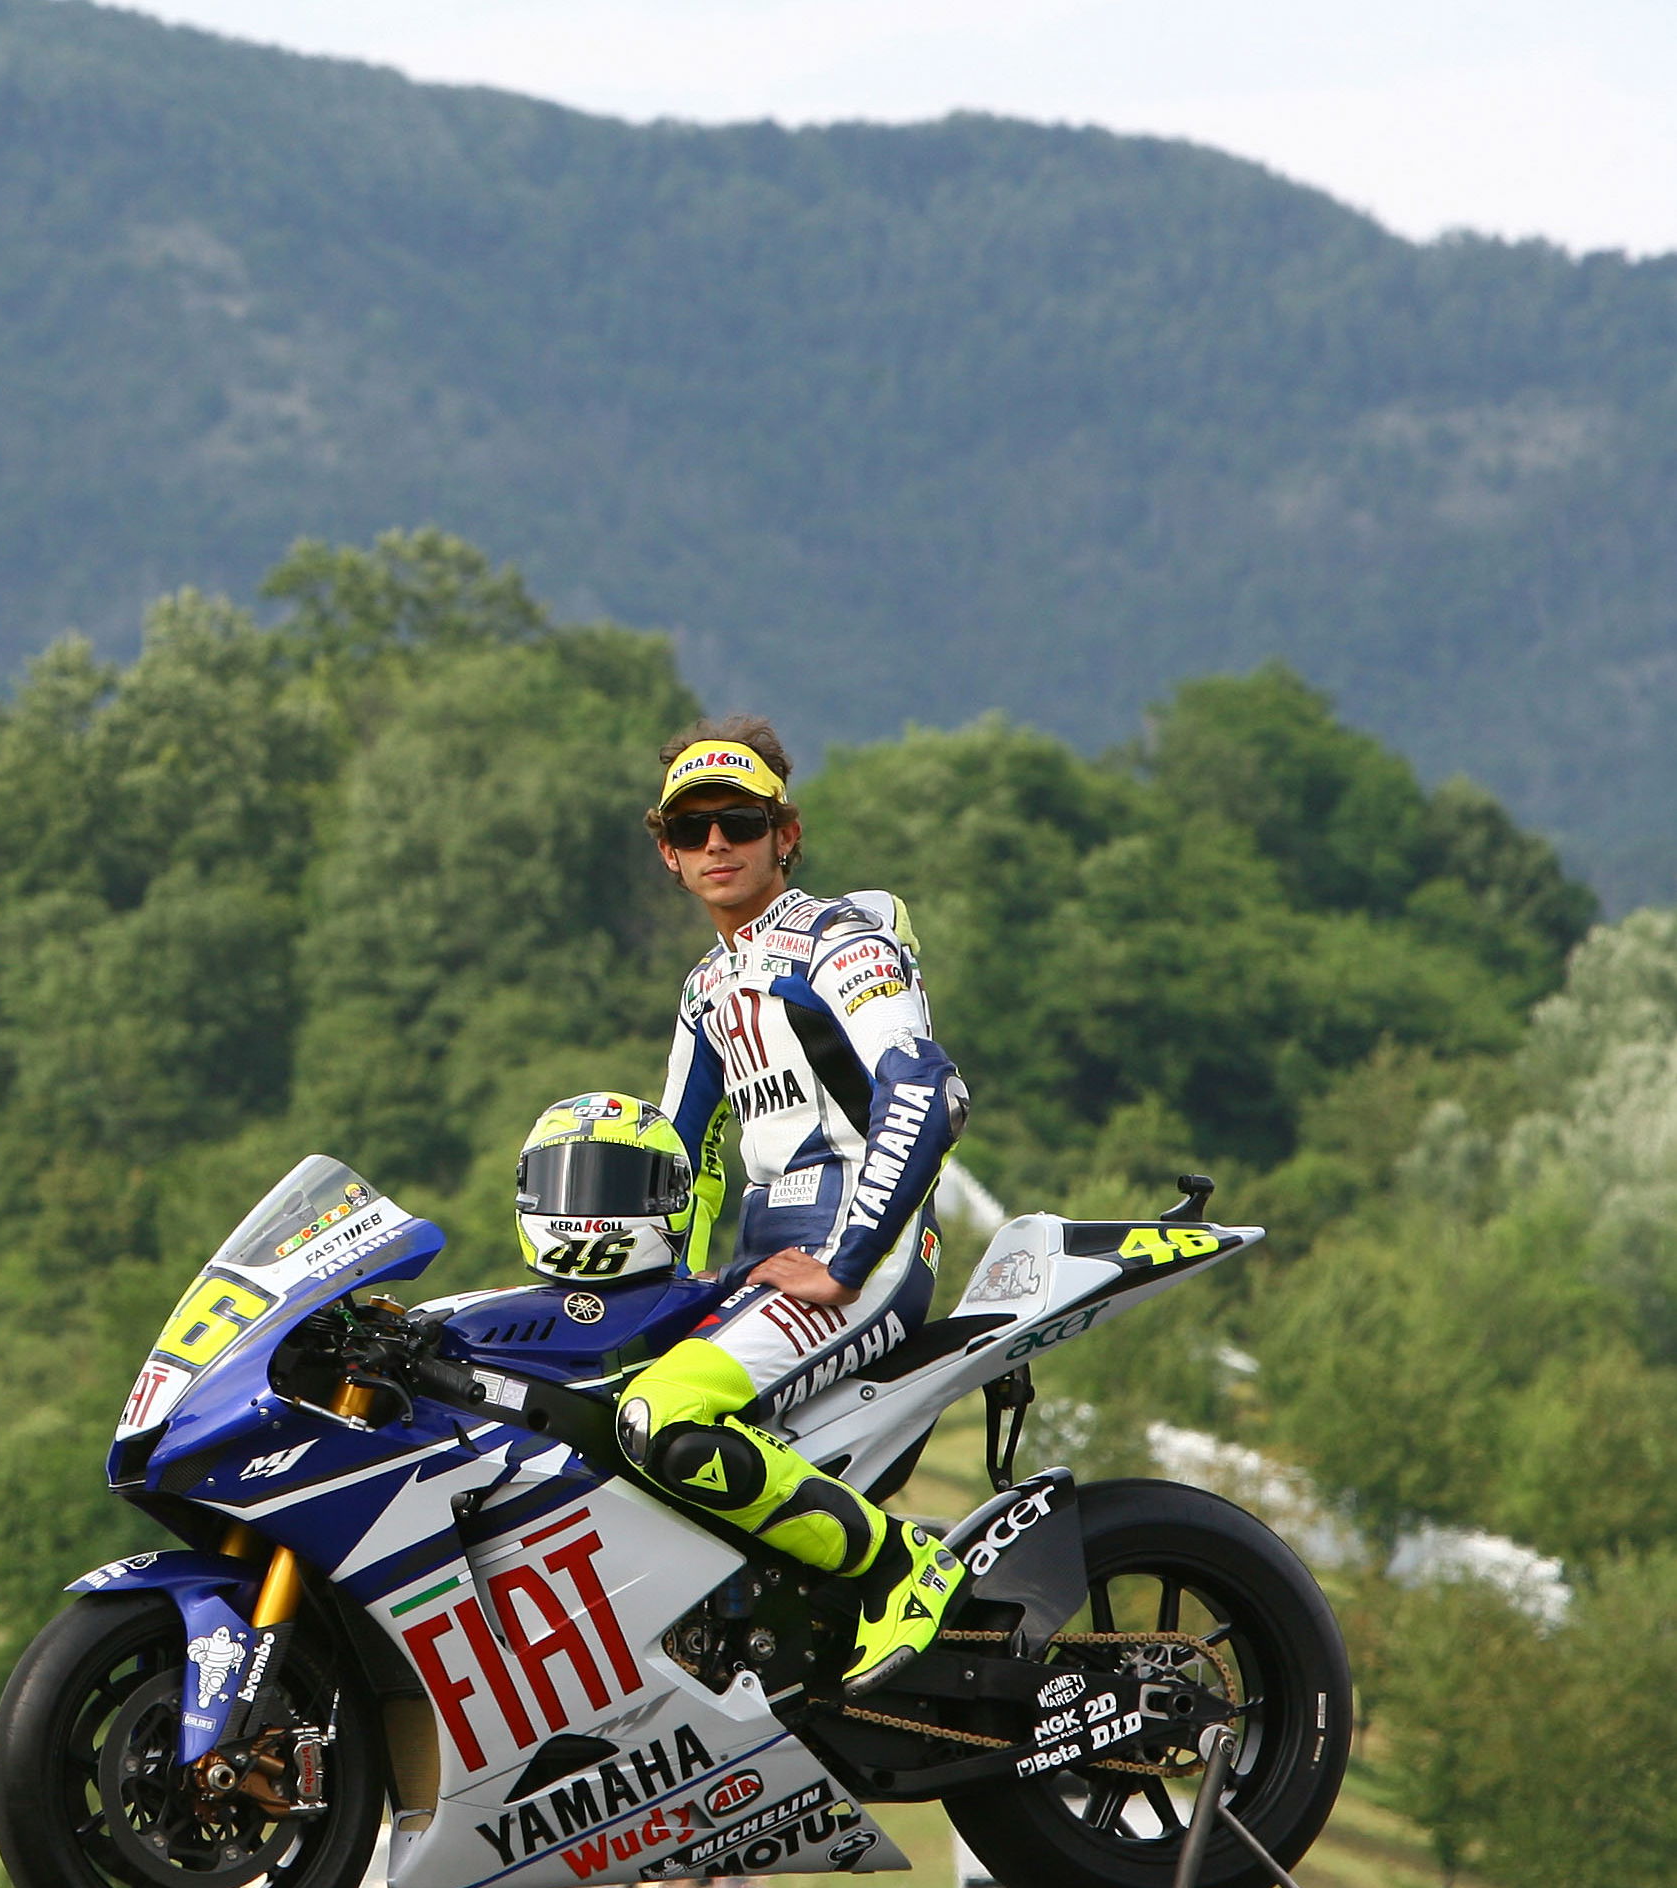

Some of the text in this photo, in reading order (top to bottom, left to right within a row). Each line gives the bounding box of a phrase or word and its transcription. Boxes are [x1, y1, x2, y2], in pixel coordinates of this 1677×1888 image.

[672, 752, 753, 780] KERAKOLL
[776, 934, 811, 956] YAMAHA
[832, 944, 879, 971] Wudy
[838, 964, 904, 998] KERAKO
[574, 1106, 621, 1119] agv
[848, 1083, 936, 1230] YAMAHA
[774, 1186, 813, 1198] LONDON
[306, 1213, 383, 1265] FASTWEB
[550, 1220, 623, 1233] KERAKOLL
[309, 1229, 403, 1280] YAMAHA
[542, 1236, 636, 1276] 46
[1118, 1228, 1219, 1265] 46
[1006, 1300, 1110, 1361] acer
[773, 1310, 906, 1417] YAMAHA
[964, 1484, 1056, 1577] acer
[237, 1632, 275, 1703] brembo
[401, 1529, 644, 1773] FIAT
[1036, 1673, 1087, 1704] MAGNETI
[1038, 1676, 1086, 1708] MARELLI
[1084, 1692, 1117, 1723] 2D
[1033, 1708, 1081, 1742] NGK
[1090, 1710, 1142, 1750] D.I.D
[302, 1746, 316, 1793] brembo
[1033, 1742, 1082, 1772] Beta
[474, 1723, 715, 1867] YAMAHA
[711, 1774, 761, 1812] AIA
[560, 1800, 696, 1880] Wudy
[690, 1787, 822, 1863] MICHELIN
